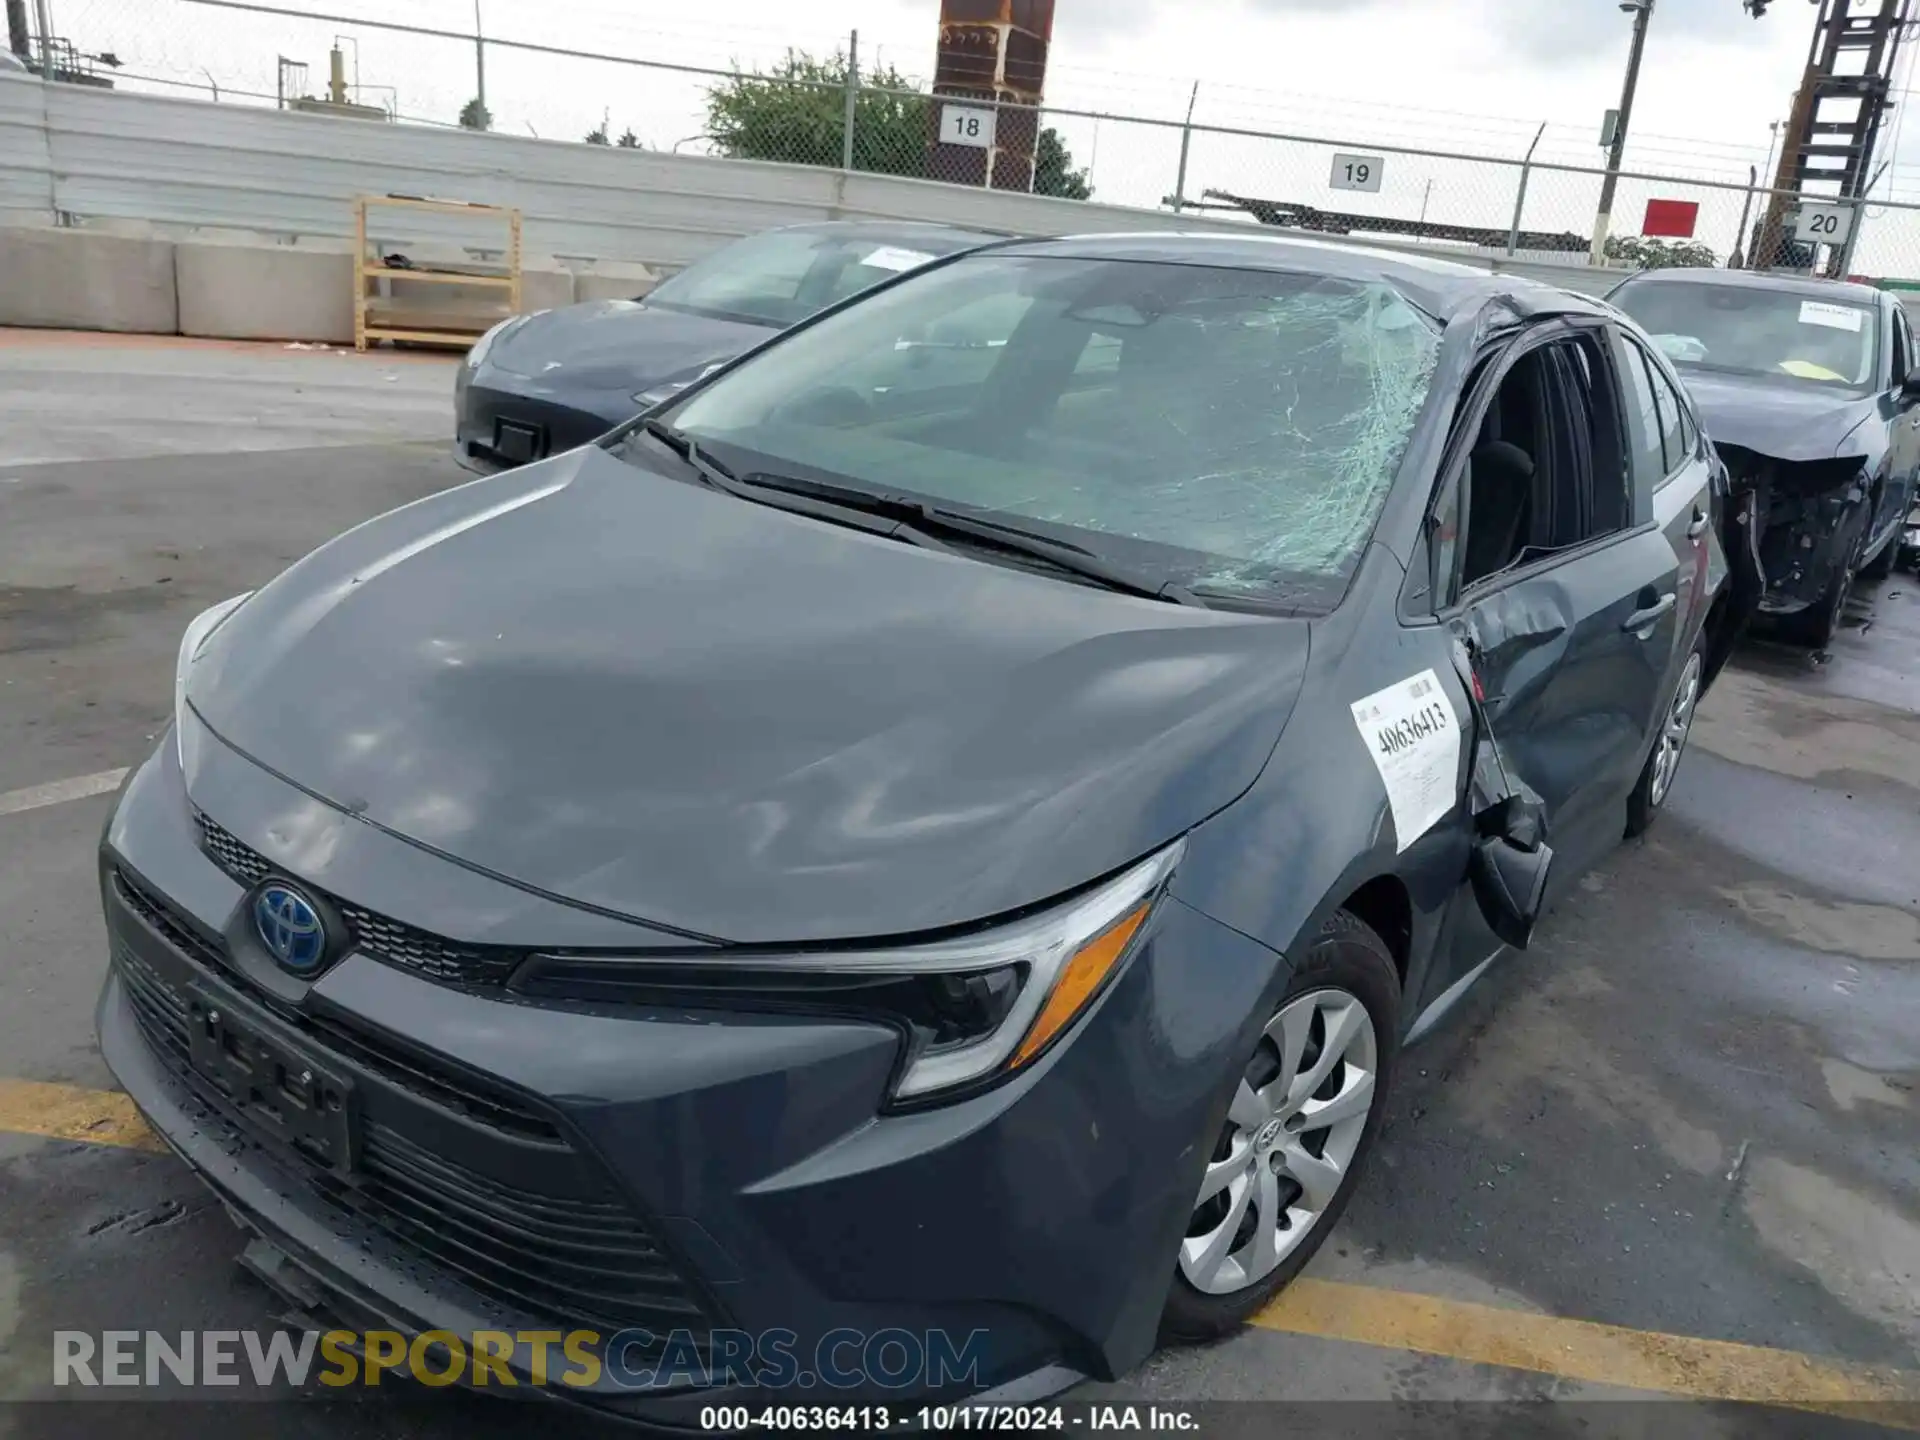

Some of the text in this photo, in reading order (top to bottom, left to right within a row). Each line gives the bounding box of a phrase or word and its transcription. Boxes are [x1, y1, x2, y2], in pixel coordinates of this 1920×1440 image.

[954, 116, 980, 138] 18
[1345, 163, 1370, 184] 19
[1809, 213, 1838, 234] 20
[1378, 702, 1446, 755] 40636413
